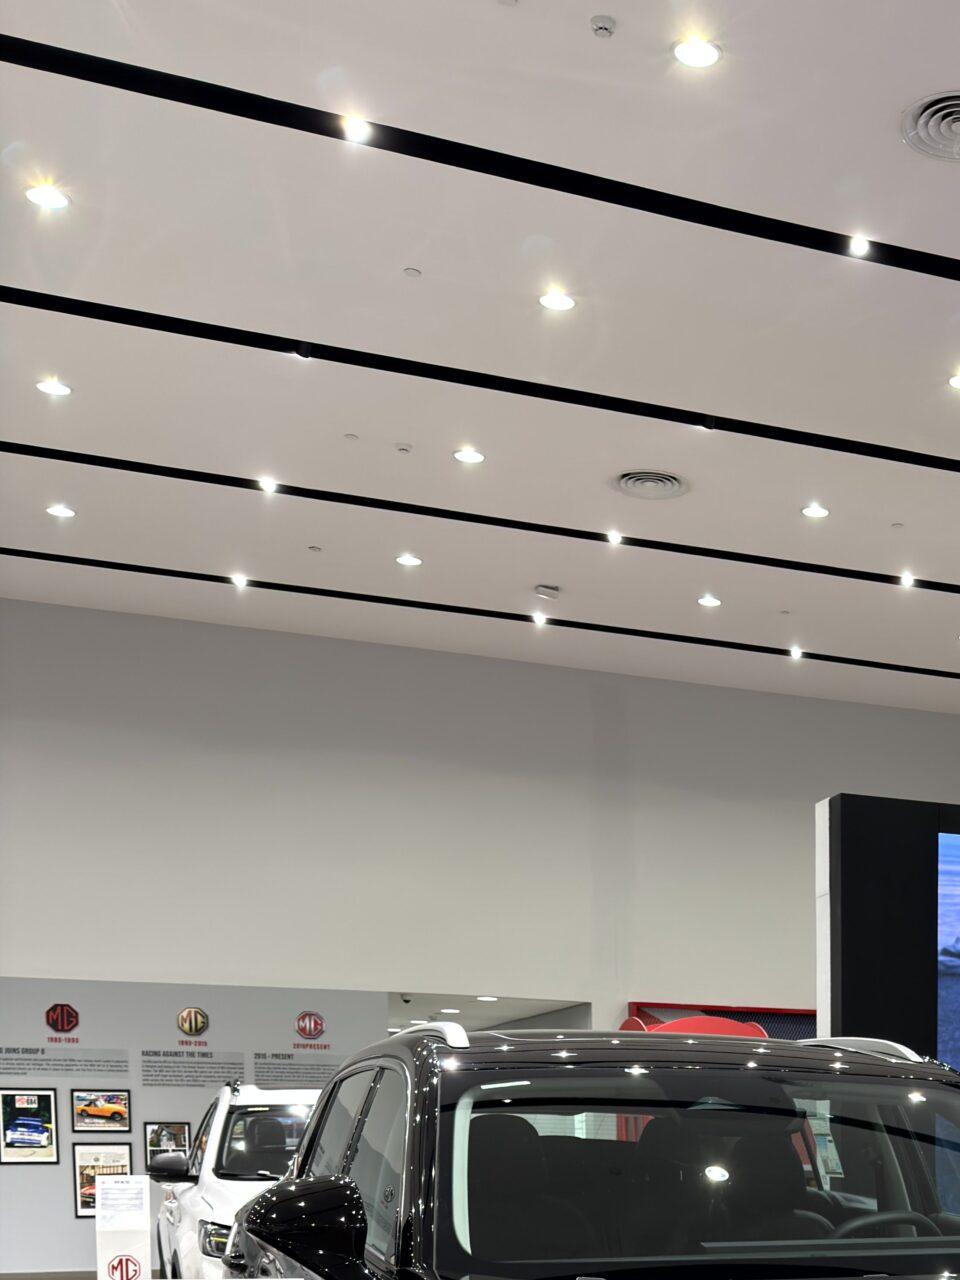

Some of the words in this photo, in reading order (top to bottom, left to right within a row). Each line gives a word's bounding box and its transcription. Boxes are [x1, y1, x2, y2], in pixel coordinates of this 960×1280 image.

[48, 1006, 78, 1031] MG
[180, 1009, 206, 1033] MG
[298, 1014, 324, 1036] MG
